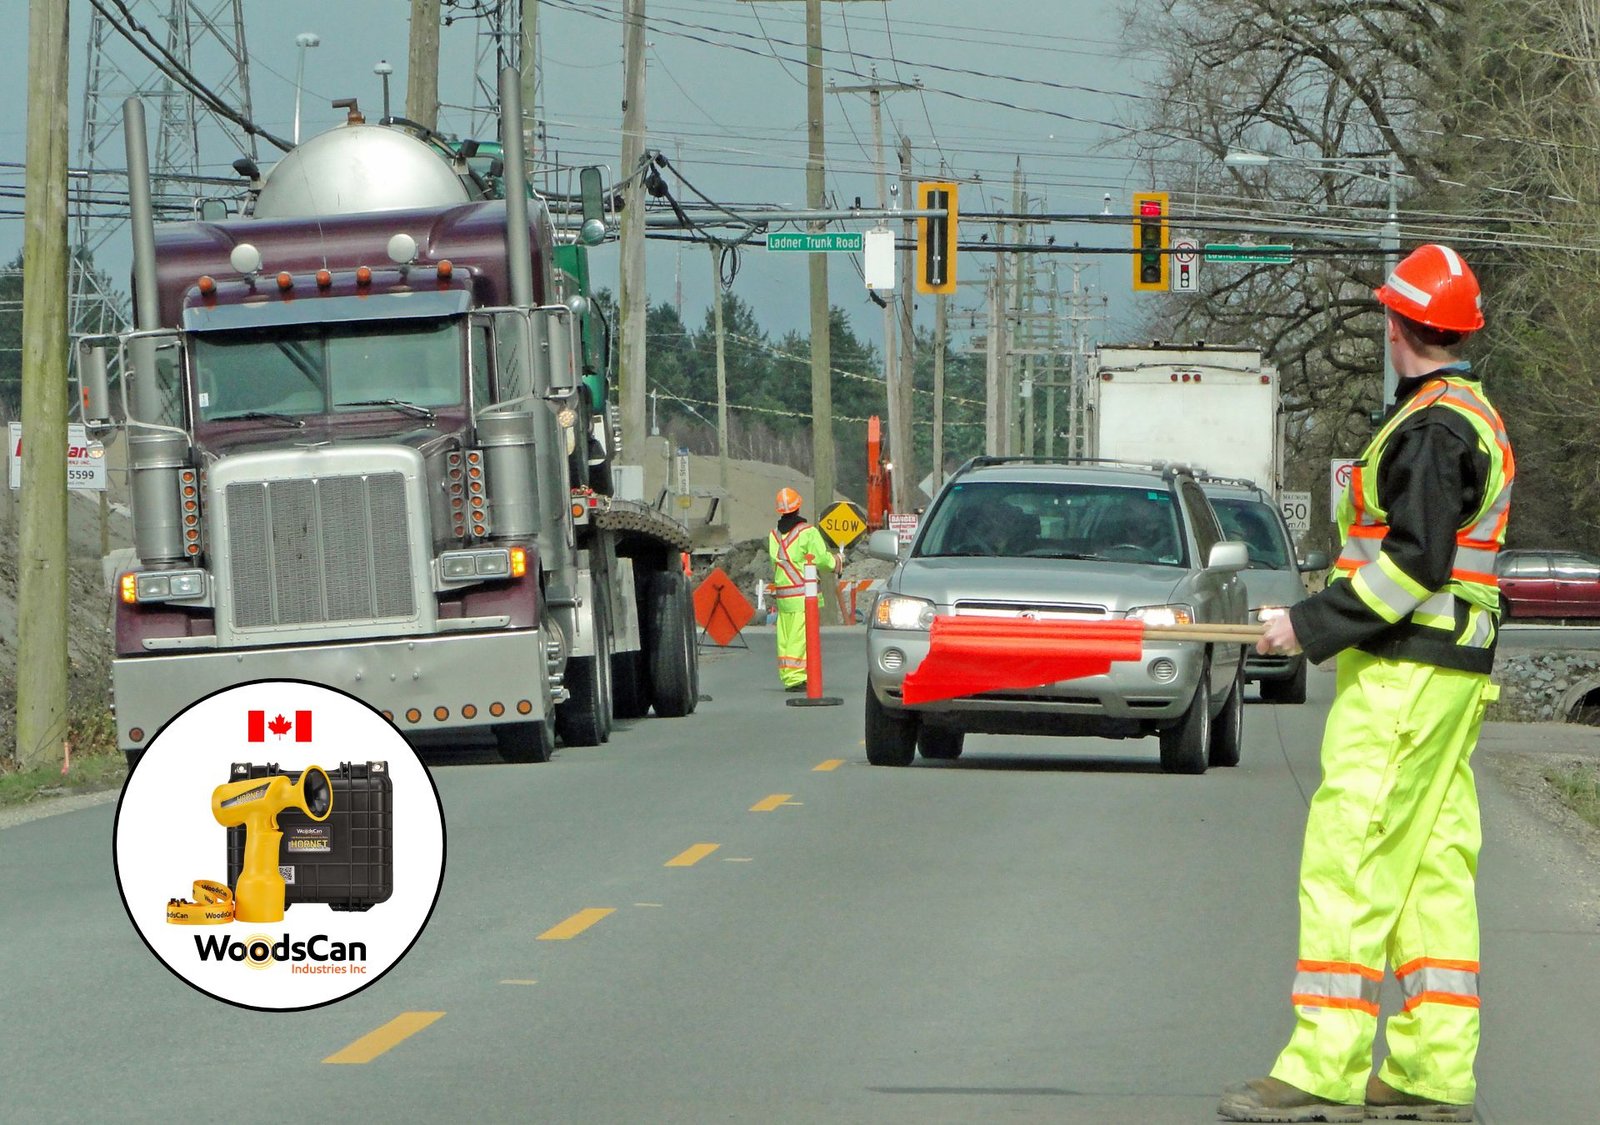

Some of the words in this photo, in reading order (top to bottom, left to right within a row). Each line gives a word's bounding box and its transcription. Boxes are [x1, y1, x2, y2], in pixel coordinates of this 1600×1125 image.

[770, 237, 801, 248] Ladner
[806, 236, 832, 248] Trunk
[836, 236, 860, 248] Road
[1284, 503, 1307, 520] 50
[826, 519, 859, 532] SLOW
